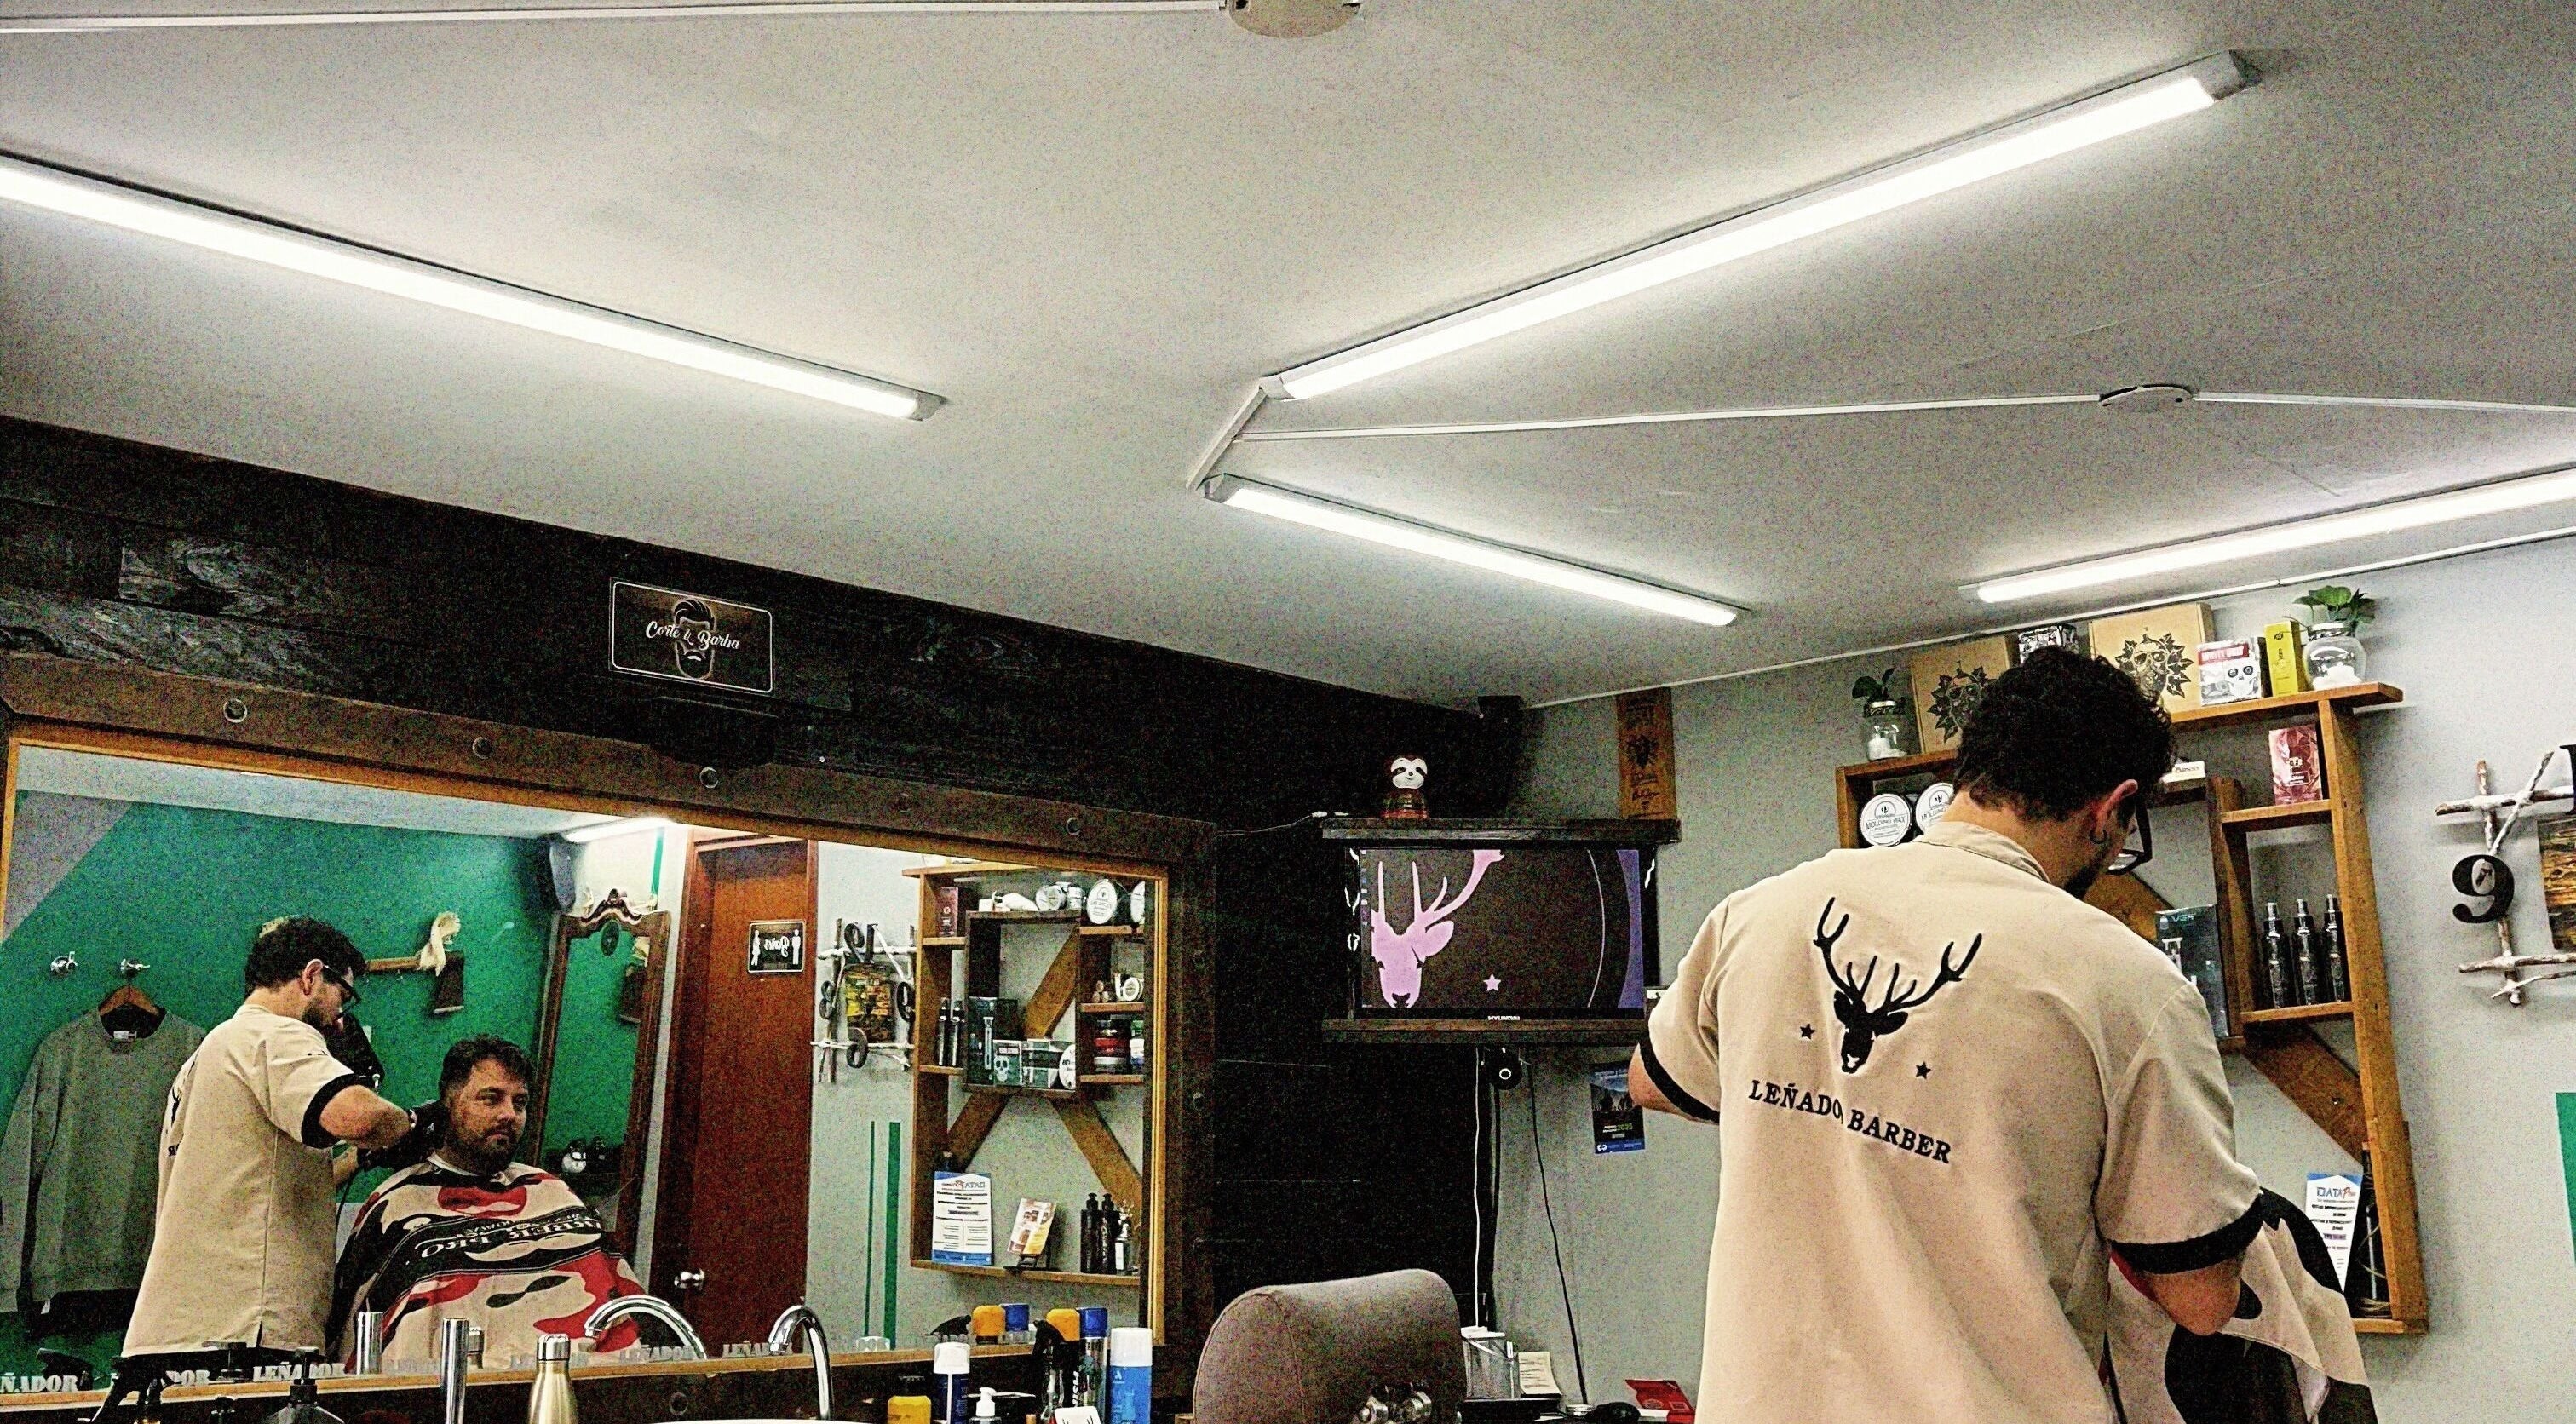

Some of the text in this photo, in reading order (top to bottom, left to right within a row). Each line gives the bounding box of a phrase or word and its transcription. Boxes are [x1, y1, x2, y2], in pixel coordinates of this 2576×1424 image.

[646, 621, 681, 639] Corte
[698, 630, 740, 651] Barba
[2452, 854, 2515, 924] 9
[1748, 1079, 1951, 1164] LEÑADO BARBER
